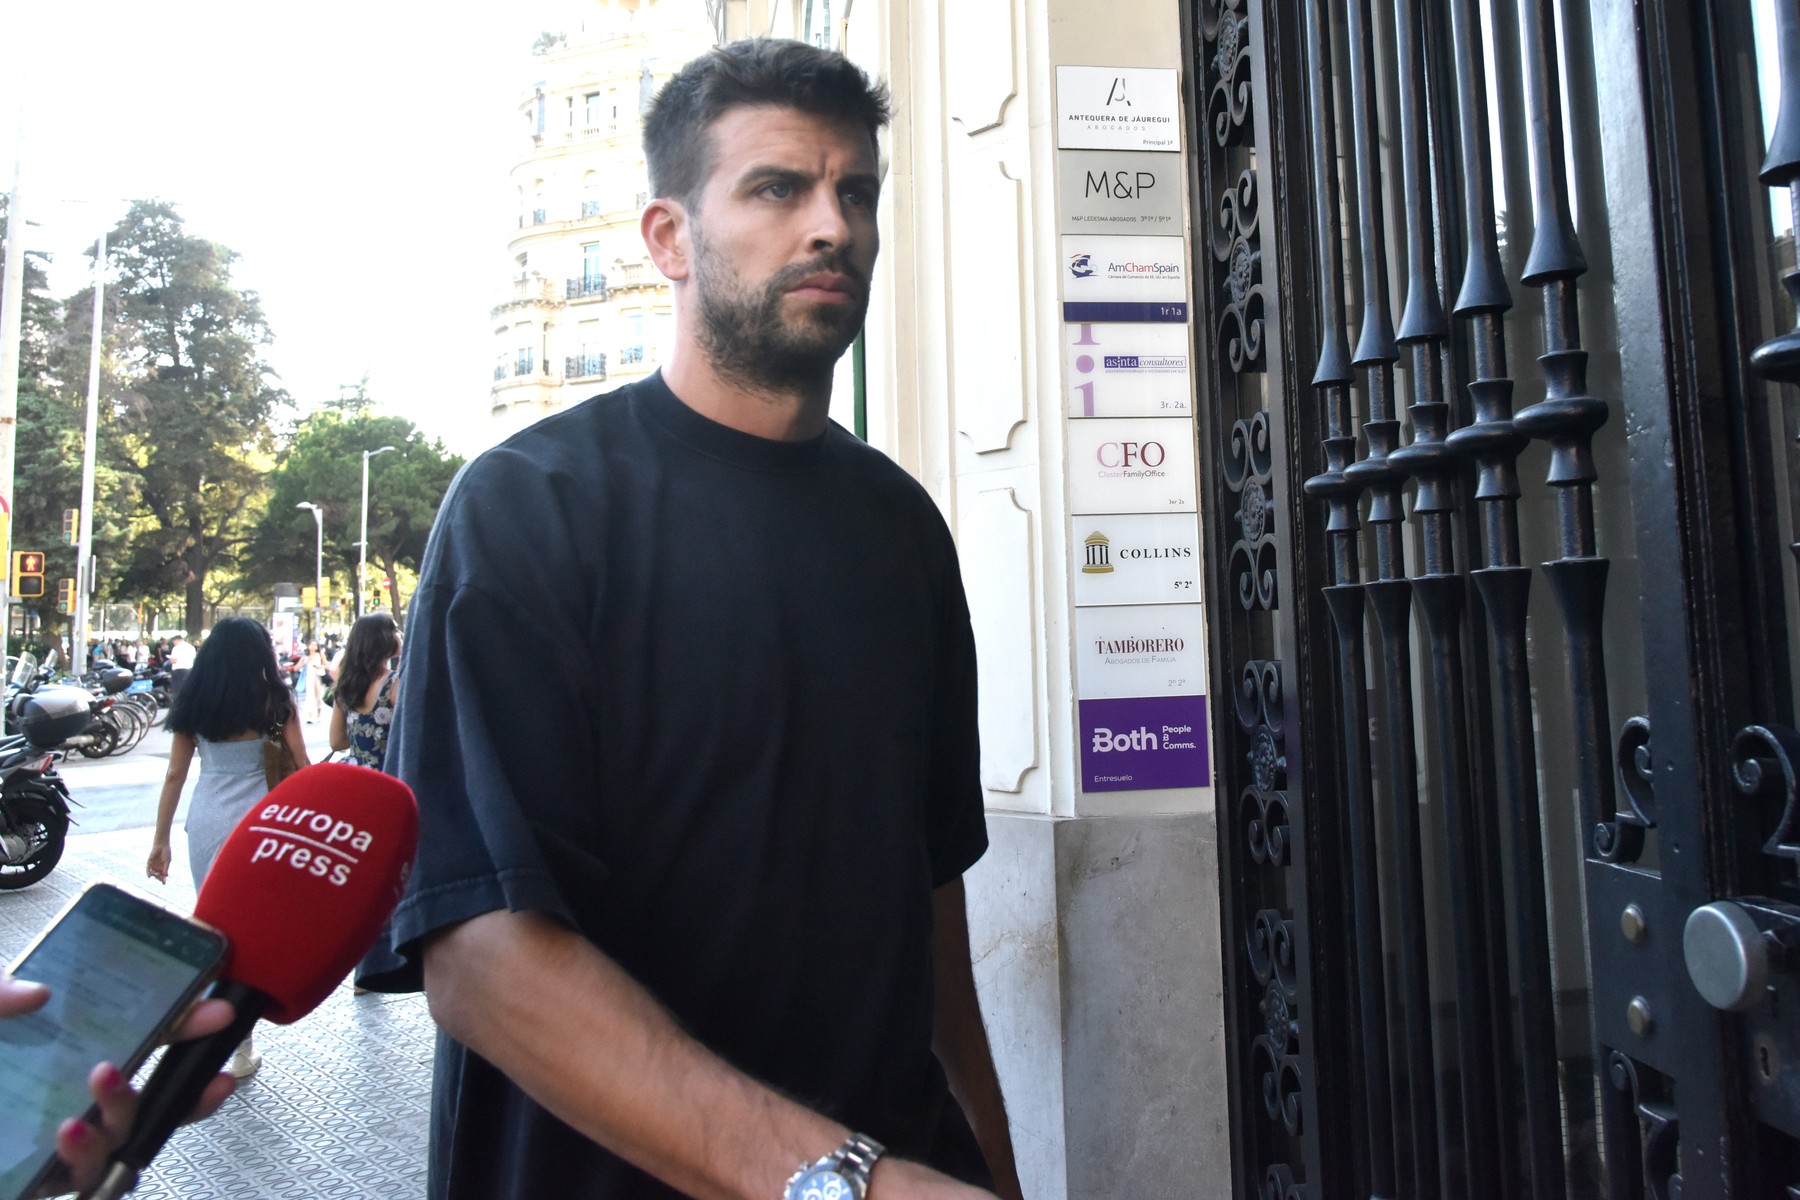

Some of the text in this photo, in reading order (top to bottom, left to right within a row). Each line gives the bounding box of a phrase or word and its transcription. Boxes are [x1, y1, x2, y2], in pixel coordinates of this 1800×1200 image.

[1068, 114, 1116, 122] ANTEQUERA
[1131, 115, 1170, 123] JÁUREGUI
[1085, 170, 1155, 199] M&P
[1107, 262, 1180, 274] AmChamSpain
[1160, 307, 1182, 316] 1r 1a
[1139, 357, 1184, 367] consultores
[1160, 401, 1187, 409] 3r. 2a.
[1096, 441, 1165, 468] CFO
[1120, 547, 1191, 559] COLLINS
[1095, 637, 1185, 654] TAMBORERO
[1162, 724, 1192, 735] People
[1092, 726, 1158, 753] Both
[1162, 741, 1197, 750] Comms.
[1094, 774, 1133, 783] Entresuelo
[259, 803, 373, 853] europa
[251, 837, 352, 886] press
